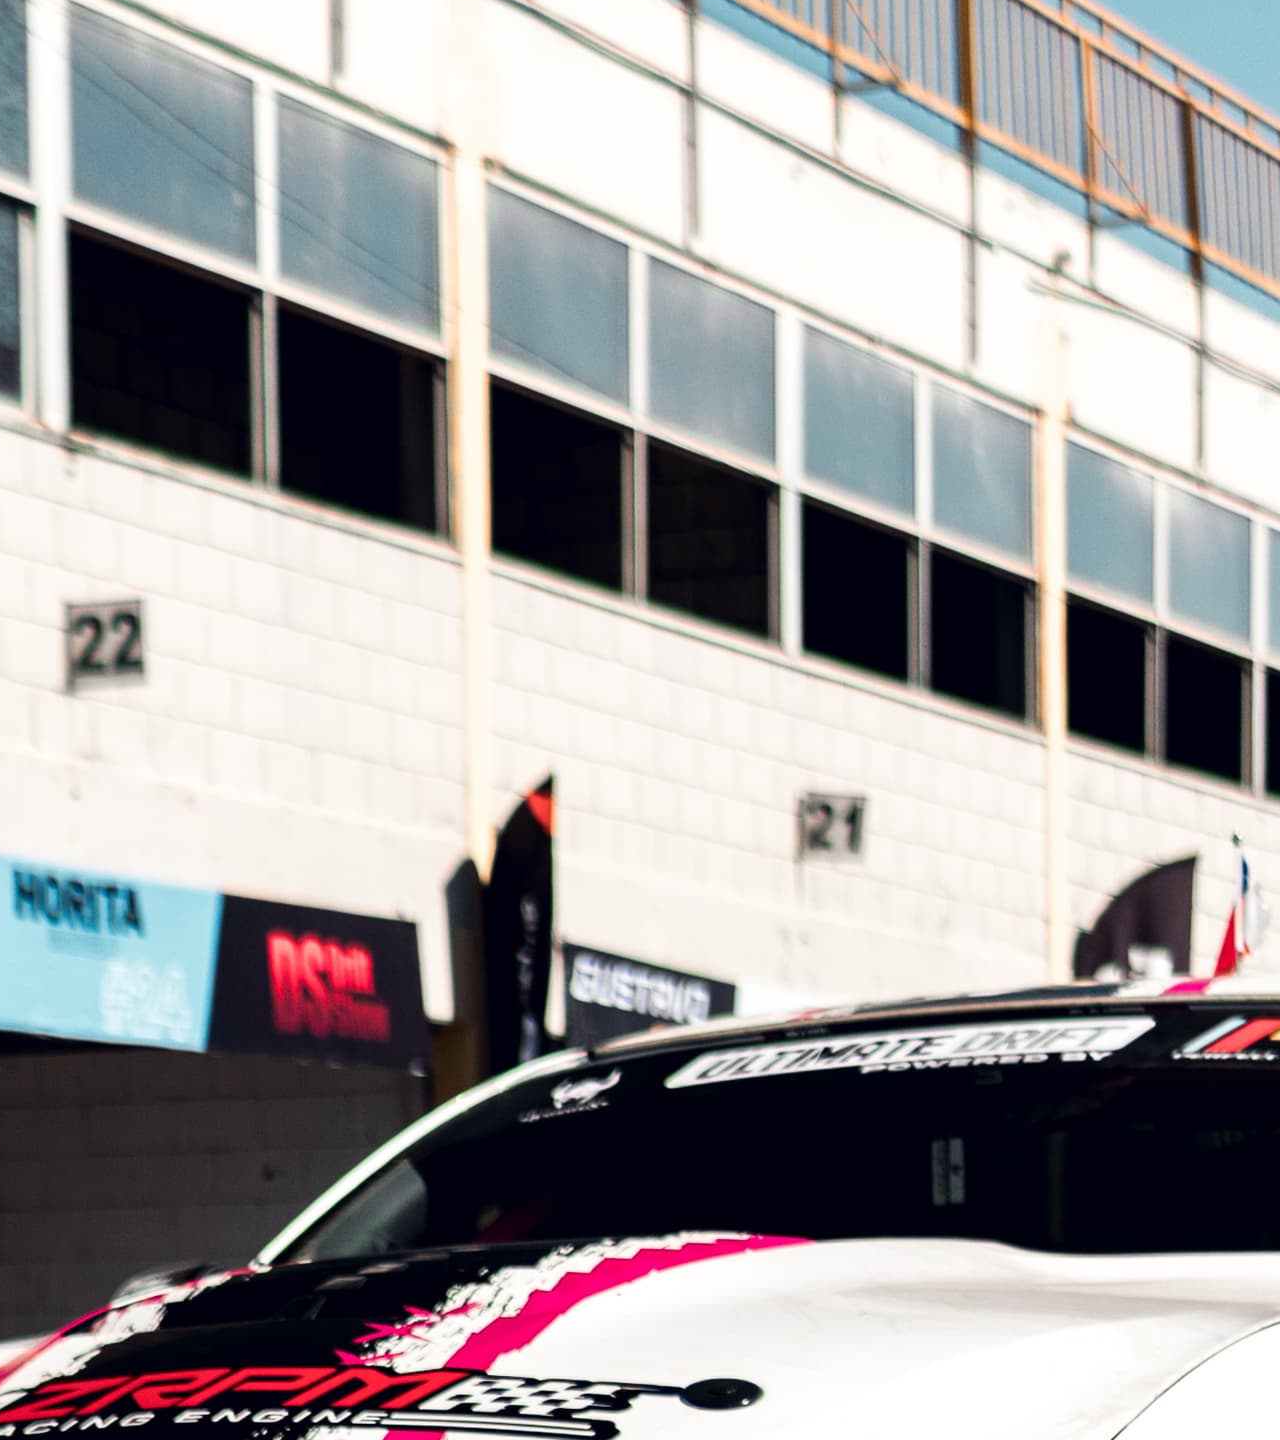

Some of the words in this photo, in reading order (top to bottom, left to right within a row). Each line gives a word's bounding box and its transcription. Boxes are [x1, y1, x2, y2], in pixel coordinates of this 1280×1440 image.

[71, 612, 143, 675] 22
[806, 800, 863, 854] 21
[11, 869, 146, 939] HORITA
[695, 1033, 955, 1081] ULTIMATE
[956, 1024, 1126, 1055] DRIFT
[860, 1052, 1051, 1074] POWERED
[1060, 1050, 1114, 1063] BY
[173, 1409, 390, 1425] ENGINE
